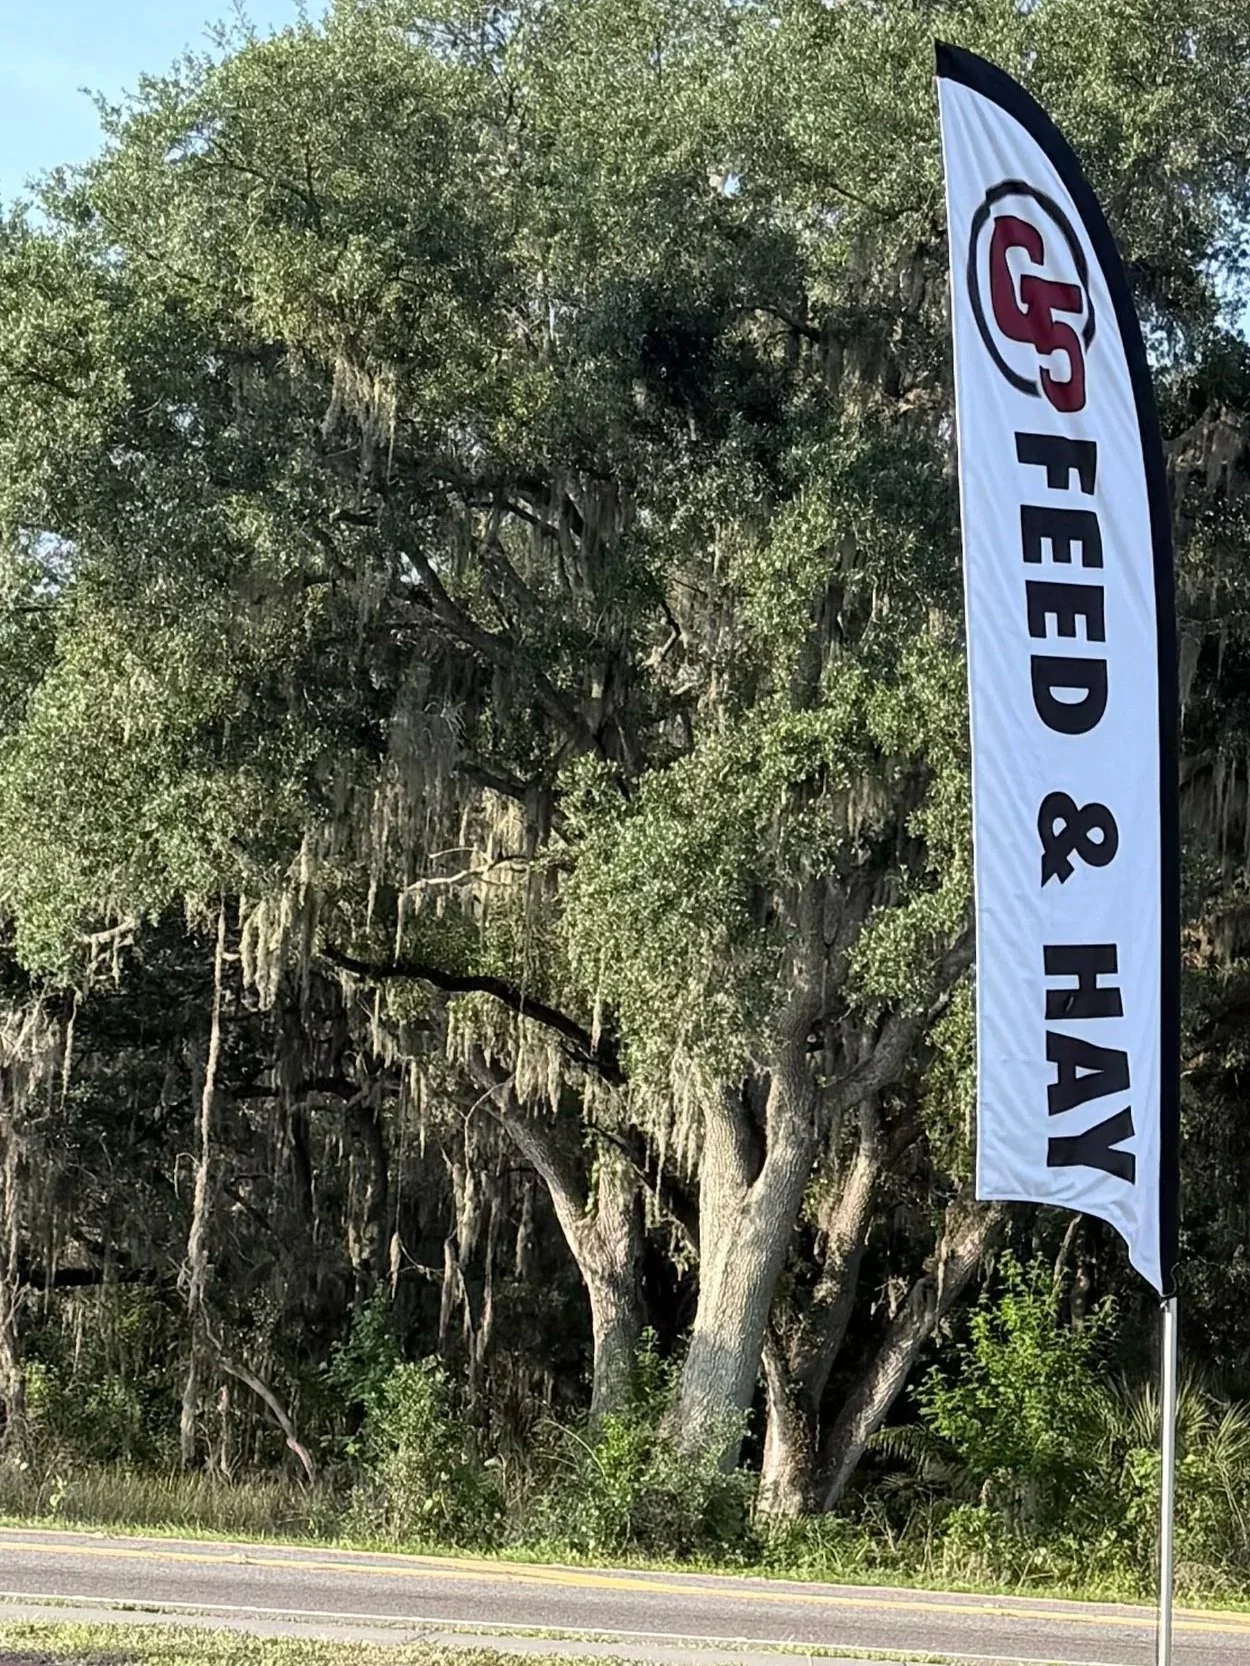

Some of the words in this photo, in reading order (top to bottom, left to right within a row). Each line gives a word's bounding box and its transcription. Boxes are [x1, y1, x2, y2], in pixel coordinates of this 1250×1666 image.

[1014, 431, 1108, 735] FEED
[1037, 791, 1119, 888] &
[1042, 943, 1136, 1185] HAY
